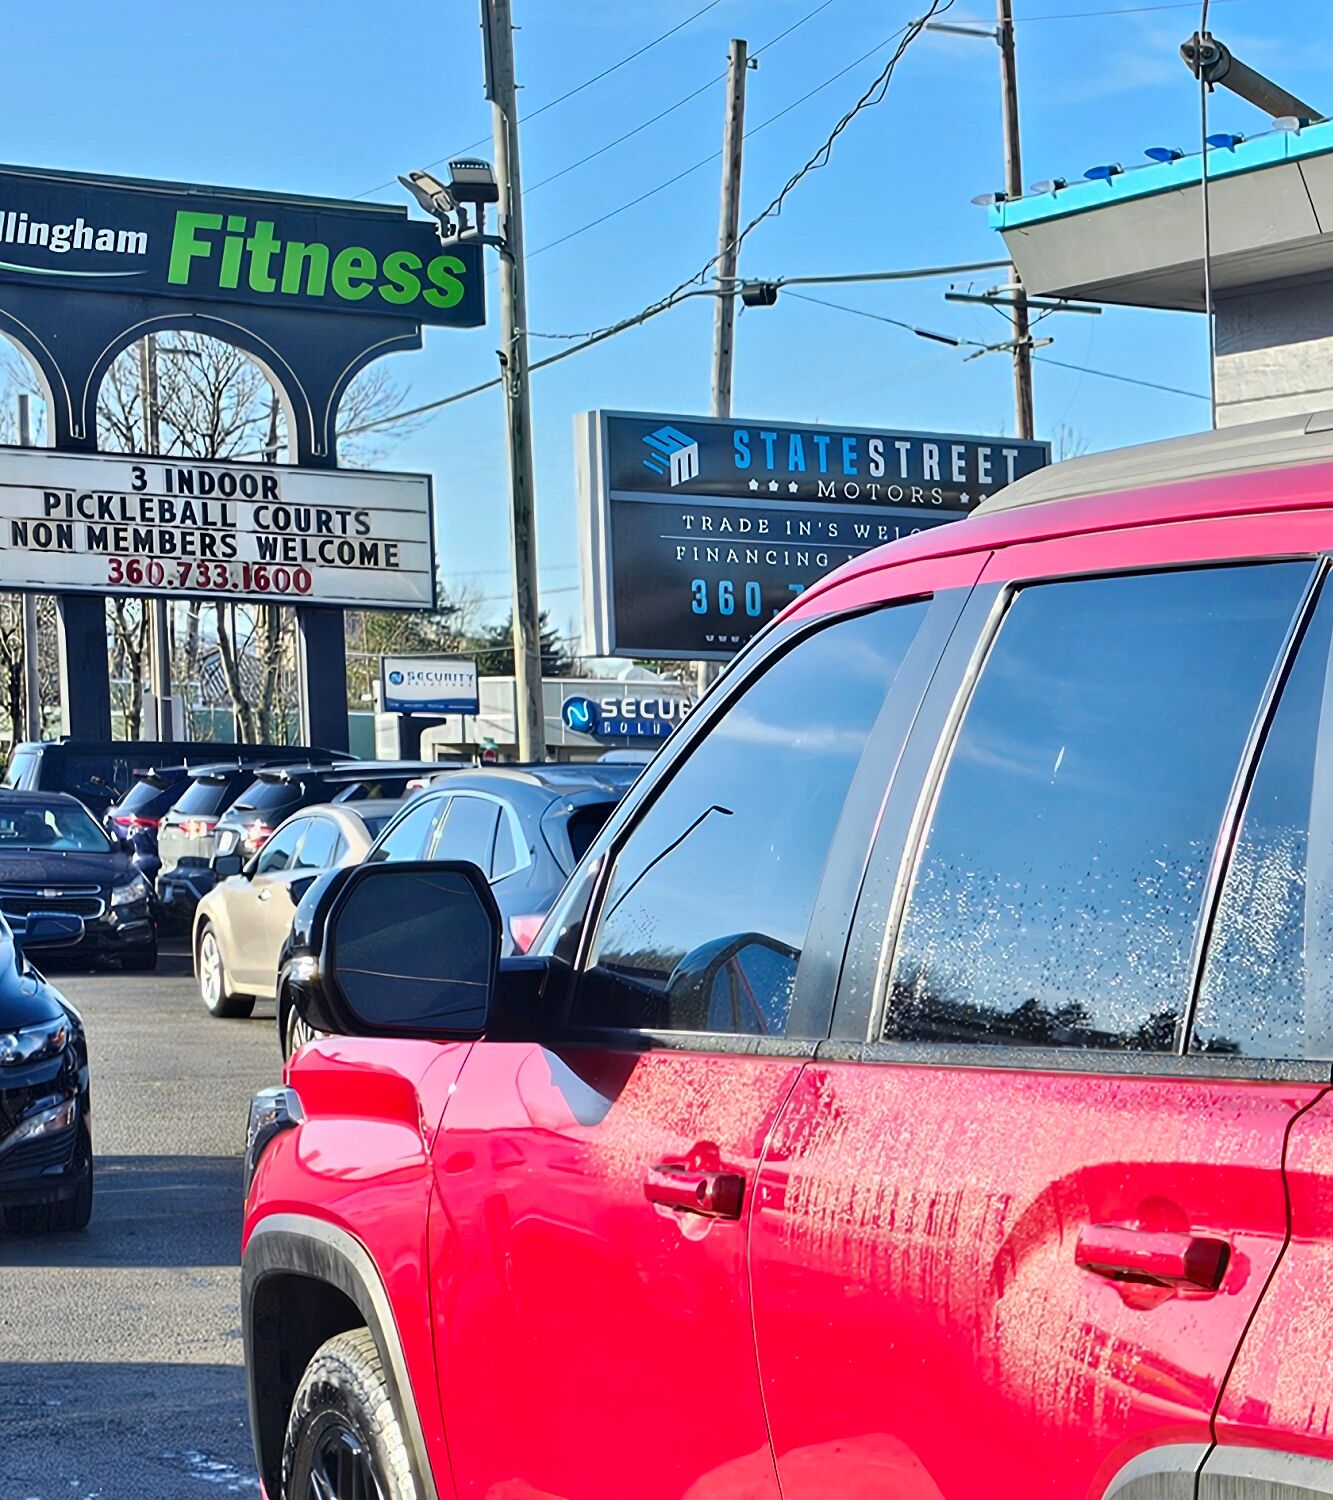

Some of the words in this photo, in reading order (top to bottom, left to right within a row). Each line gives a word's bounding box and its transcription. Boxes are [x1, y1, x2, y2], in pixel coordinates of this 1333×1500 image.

[168, 210, 466, 308] Fitness
[131, 466, 148, 491] 3
[165, 468, 280, 501] INDOOR
[817, 479, 943, 504] MOTORS
[43, 491, 237, 528] PICKLEBALL
[253, 505, 371, 536] COURTS
[682, 515, 769, 534] TRADE
[786, 520, 838, 537] IN'S
[11, 521, 73, 549] NON
[87, 524, 237, 559] MEMBERS
[255, 535, 399, 568] WELCOME
[676, 545, 828, 567] FINANCING
[107, 557, 312, 594] 360.733.1600
